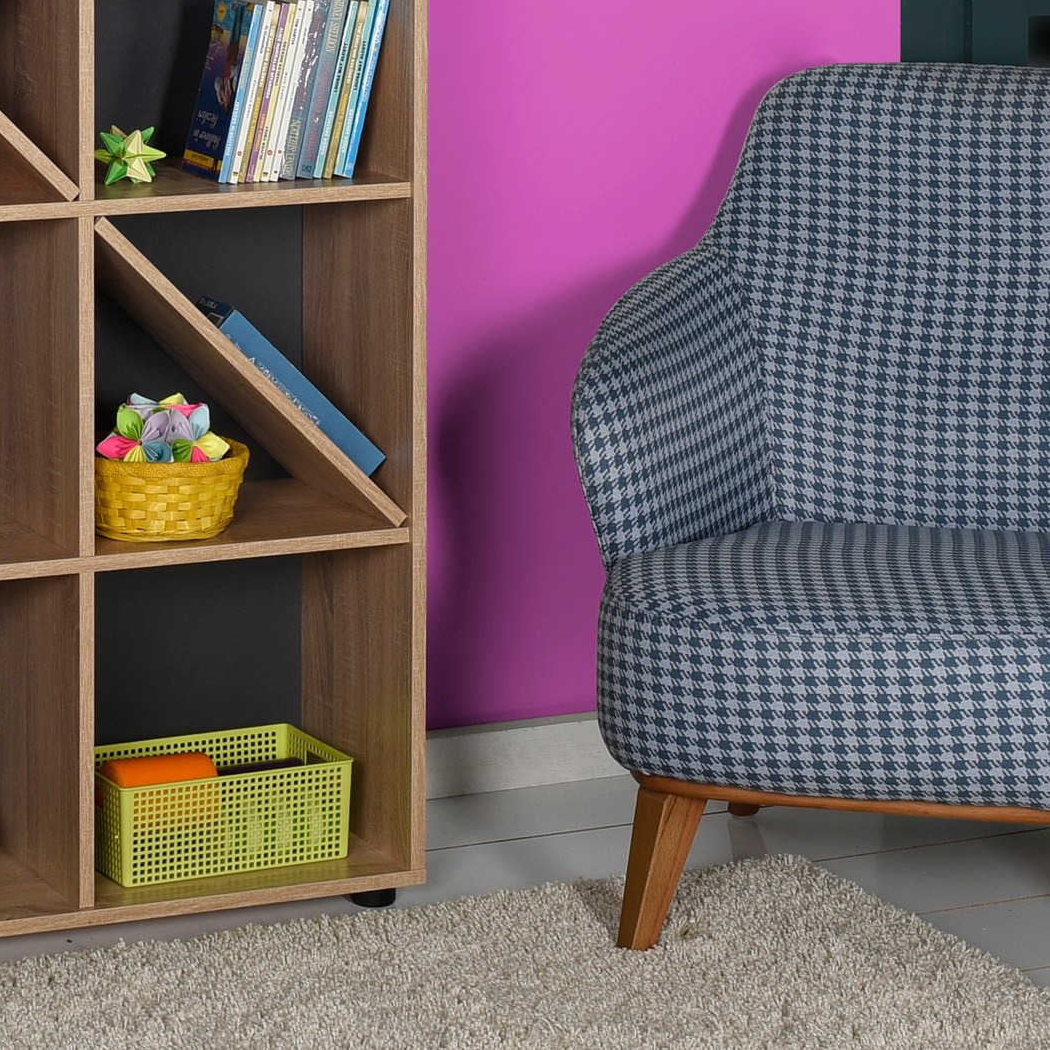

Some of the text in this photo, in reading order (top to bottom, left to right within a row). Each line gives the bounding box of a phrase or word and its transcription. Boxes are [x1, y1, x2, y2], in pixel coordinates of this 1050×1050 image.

[324, 22, 341, 54] SHELDON
[274, 63, 283, 86] CHARLES
[333, 74, 341, 93] LOUISA
[340, 43, 348, 62] ALCOTT
[353, 71, 361, 91] LOUISA
[359, 40, 367, 60] ALCOTT
